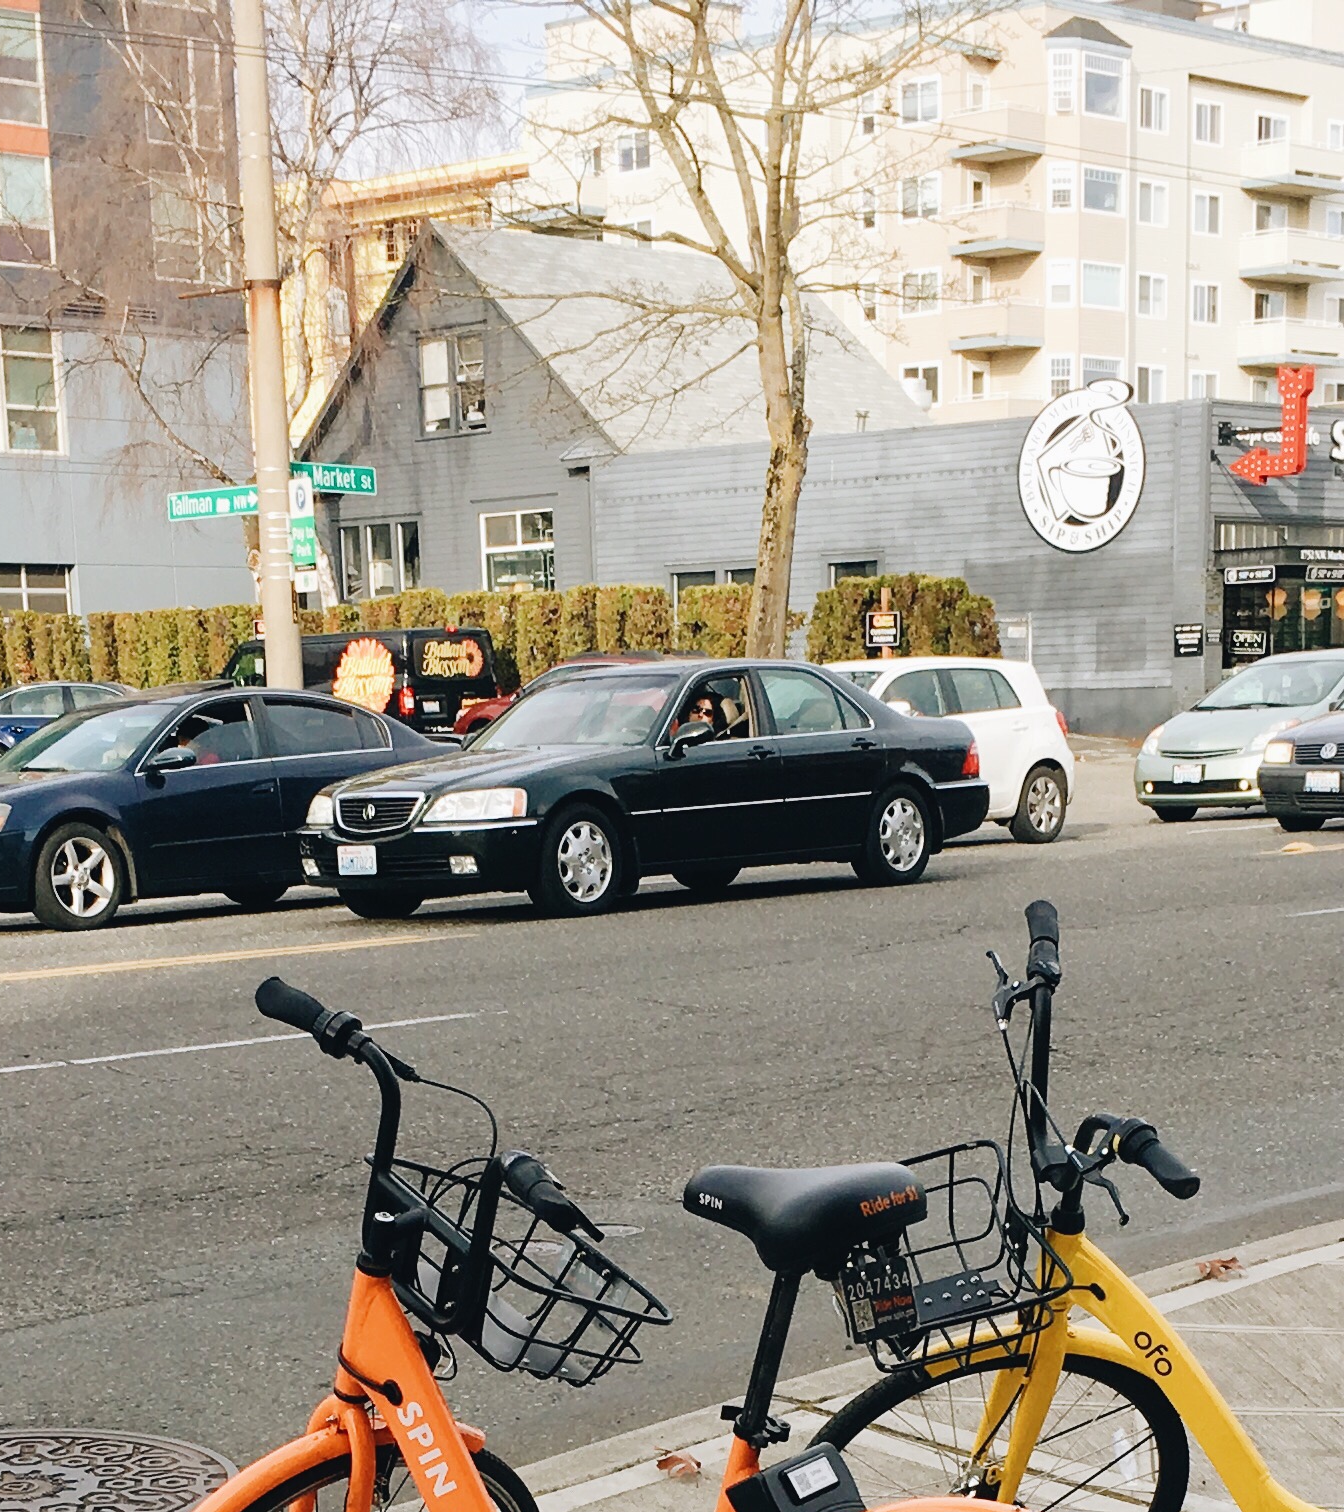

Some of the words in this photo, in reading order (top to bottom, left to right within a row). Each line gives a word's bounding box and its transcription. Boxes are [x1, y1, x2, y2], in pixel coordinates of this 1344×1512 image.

[312, 466, 357, 490] Market
[360, 475, 372, 490] St
[170, 495, 213, 516] Tallman
[1039, 516, 1066, 541] SIP
[1084, 508, 1123, 545] SHIP
[423, 640, 467, 659] Ballard
[698, 1192, 724, 1210] SPIN
[859, 1195, 890, 1217] Ride
[889, 1190, 906, 1206] for
[847, 1270, 910, 1301] 2047434
[1134, 1331, 1173, 1377] ofo
[397, 1401, 458, 1498] SPIN
